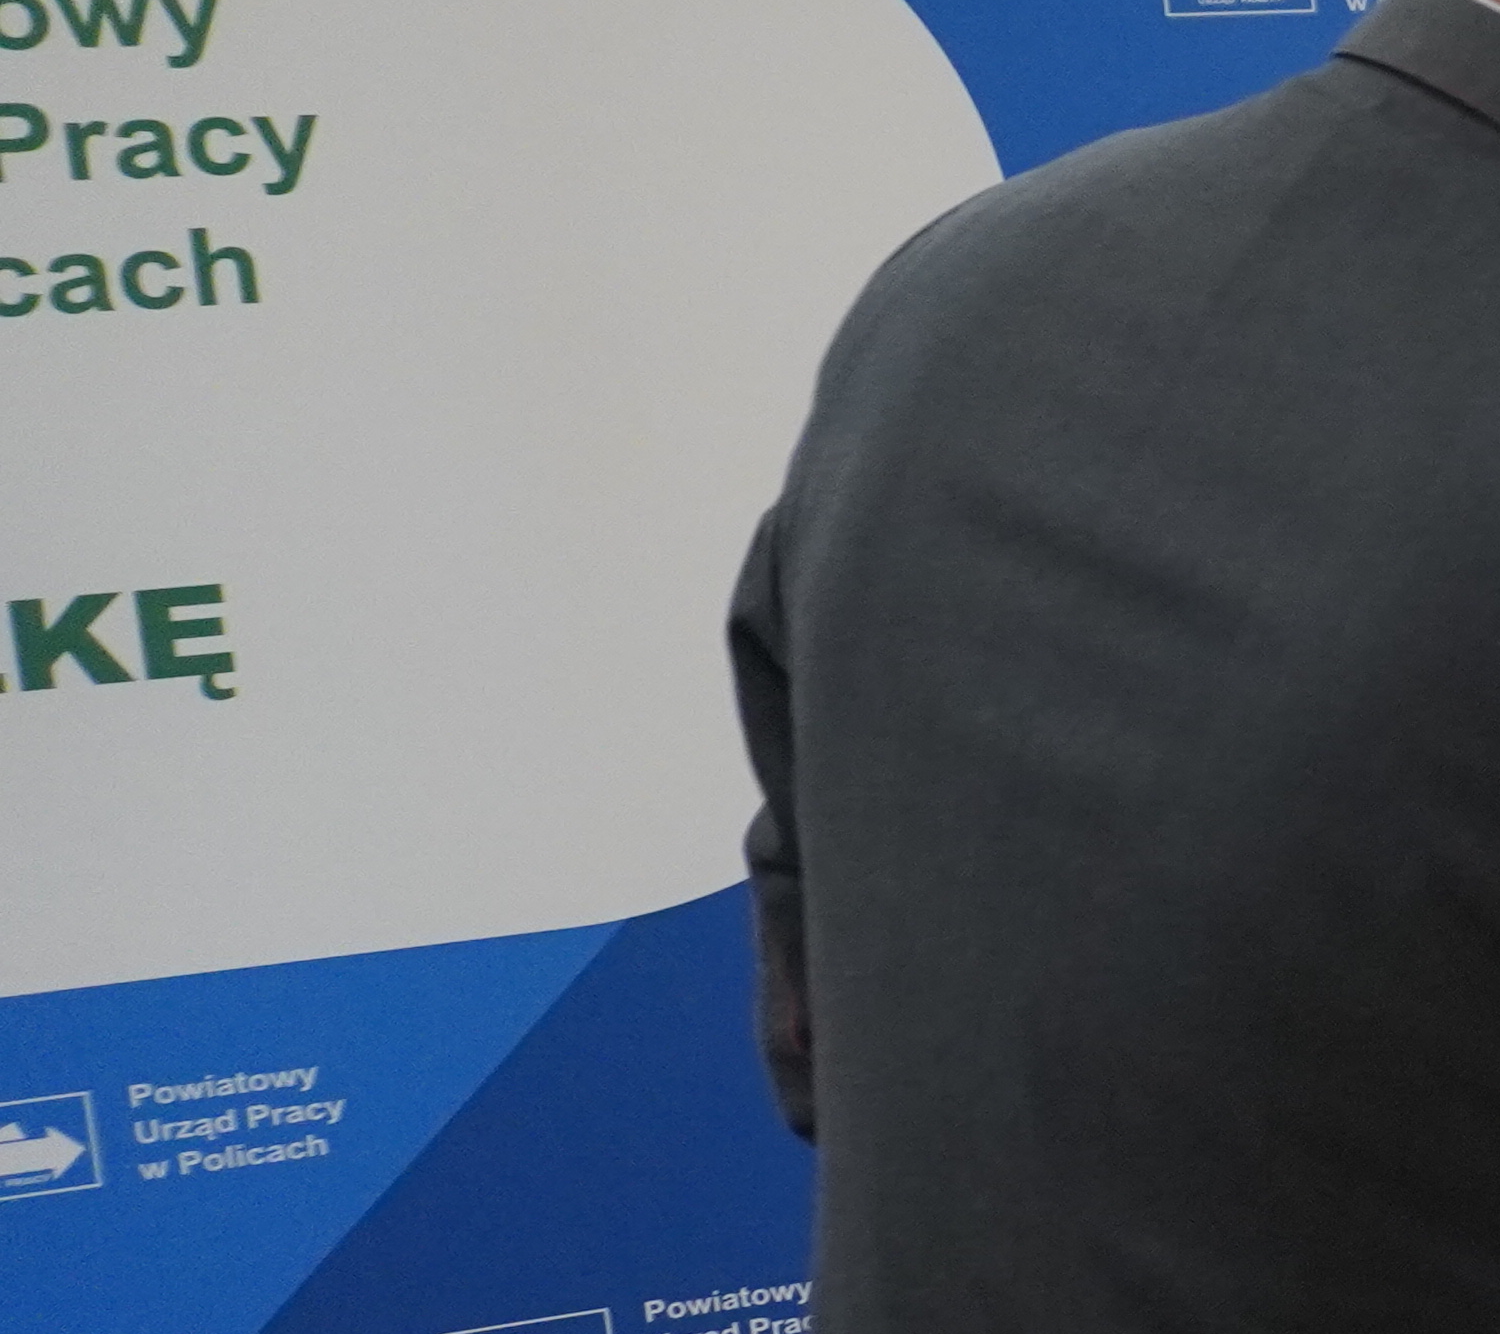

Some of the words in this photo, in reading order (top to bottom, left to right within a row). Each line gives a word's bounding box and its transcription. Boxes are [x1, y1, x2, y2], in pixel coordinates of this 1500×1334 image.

[0, 102, 318, 196] Pracy
[0, 583, 237, 700] KĘ
[127, 1066, 319, 1108] Powiatowy
[134, 1109, 239, 1144] Urząd
[245, 1098, 347, 1129] Pracy
[138, 1160, 169, 1180] w
[177, 1134, 330, 1175] Policach
[644, 1280, 813, 1323] Powiatowy
